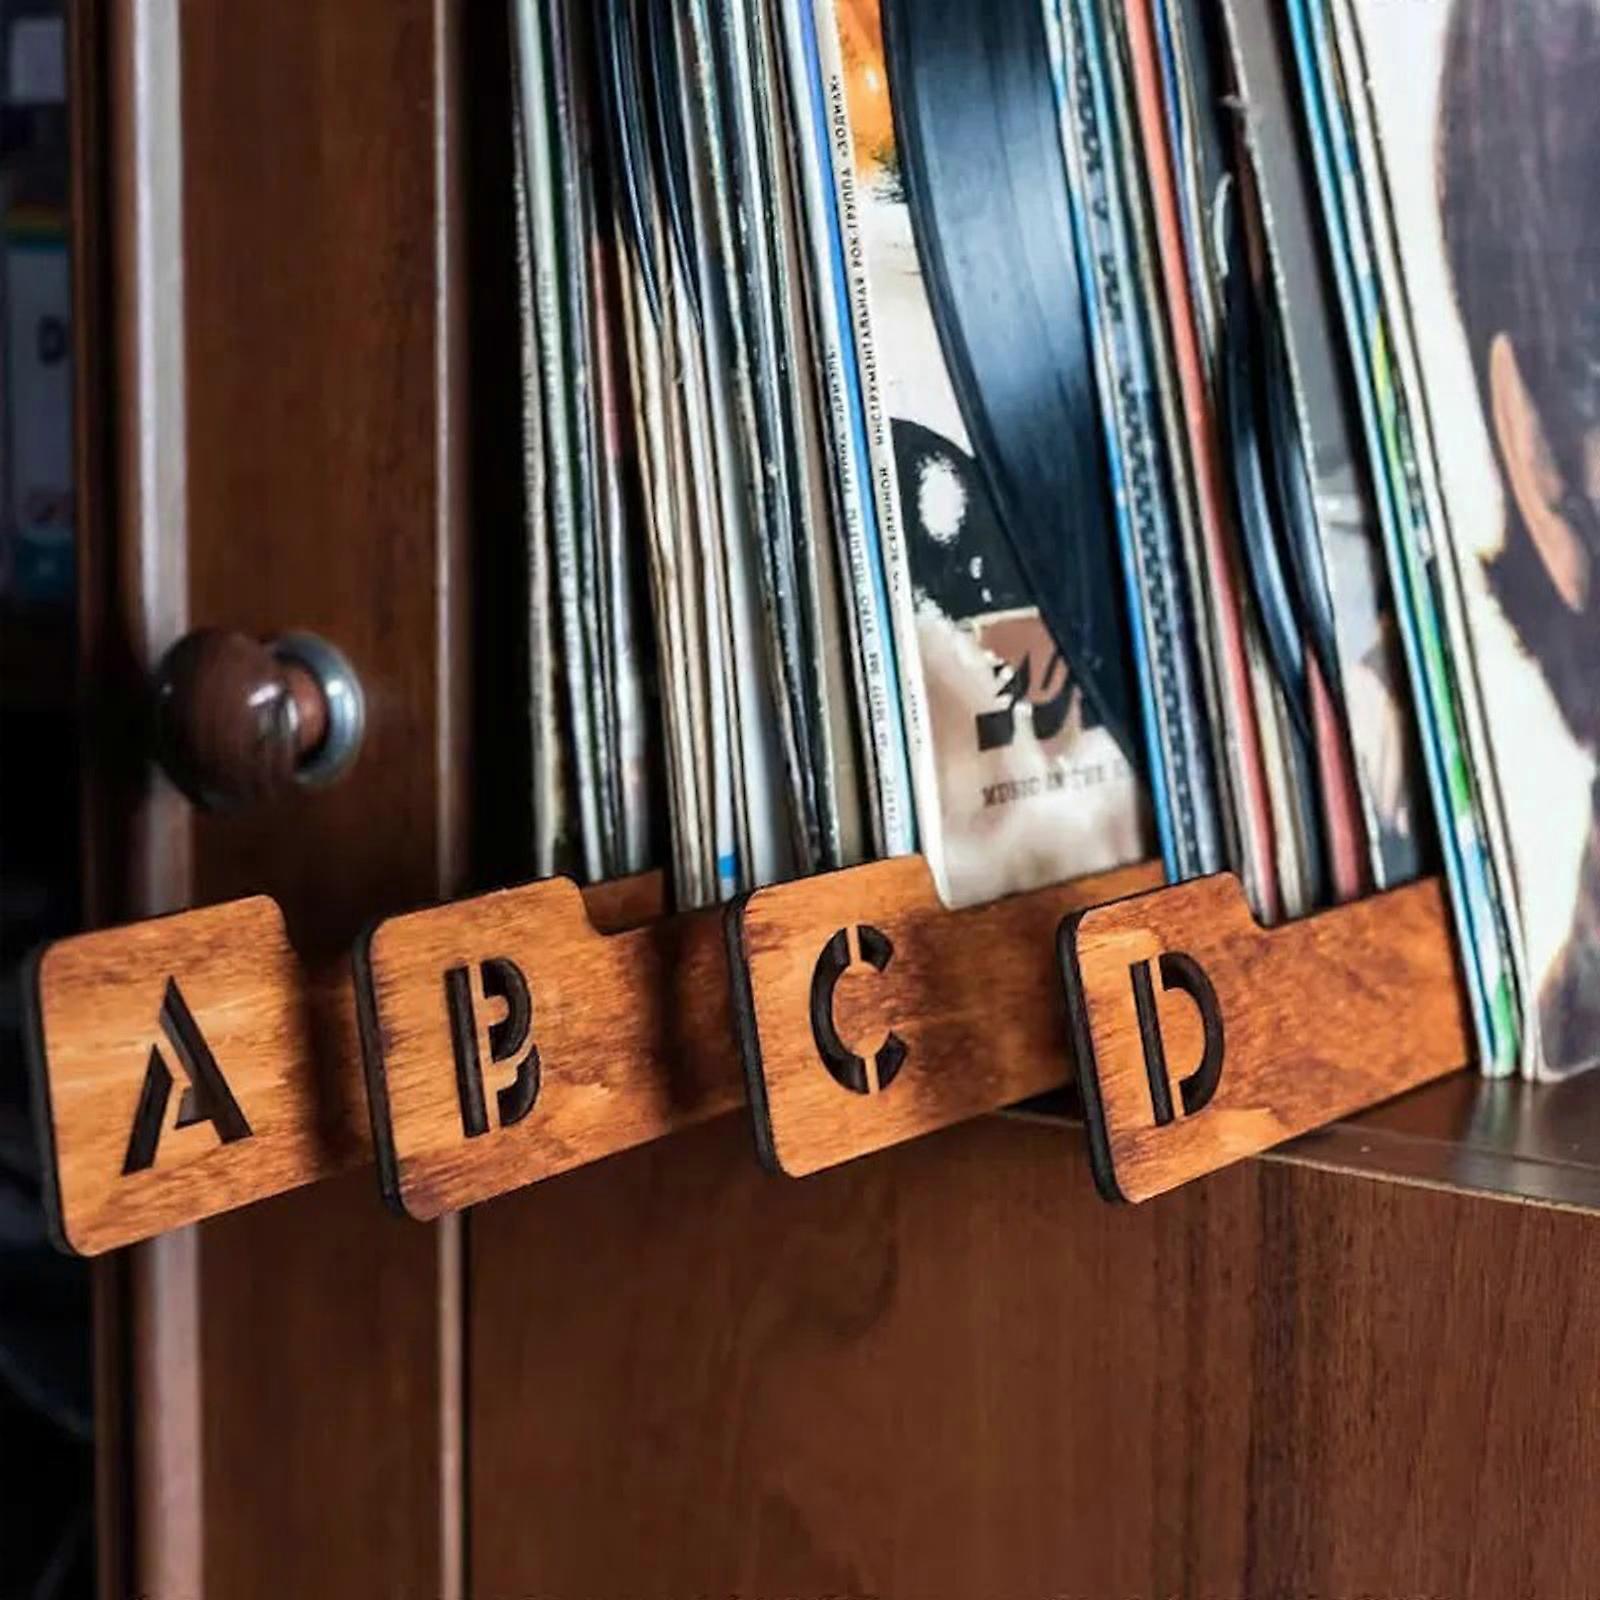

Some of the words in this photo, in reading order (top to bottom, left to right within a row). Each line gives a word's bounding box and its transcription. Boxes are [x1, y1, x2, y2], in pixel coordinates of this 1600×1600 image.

[855, 277, 884, 445] ИНСТРУМЕНТАЛЬНАЯ
[122, 975, 252, 1176] A
[445, 956, 541, 1138] B
[811, 925, 908, 1094] C
[1129, 950, 1225, 1126] D
